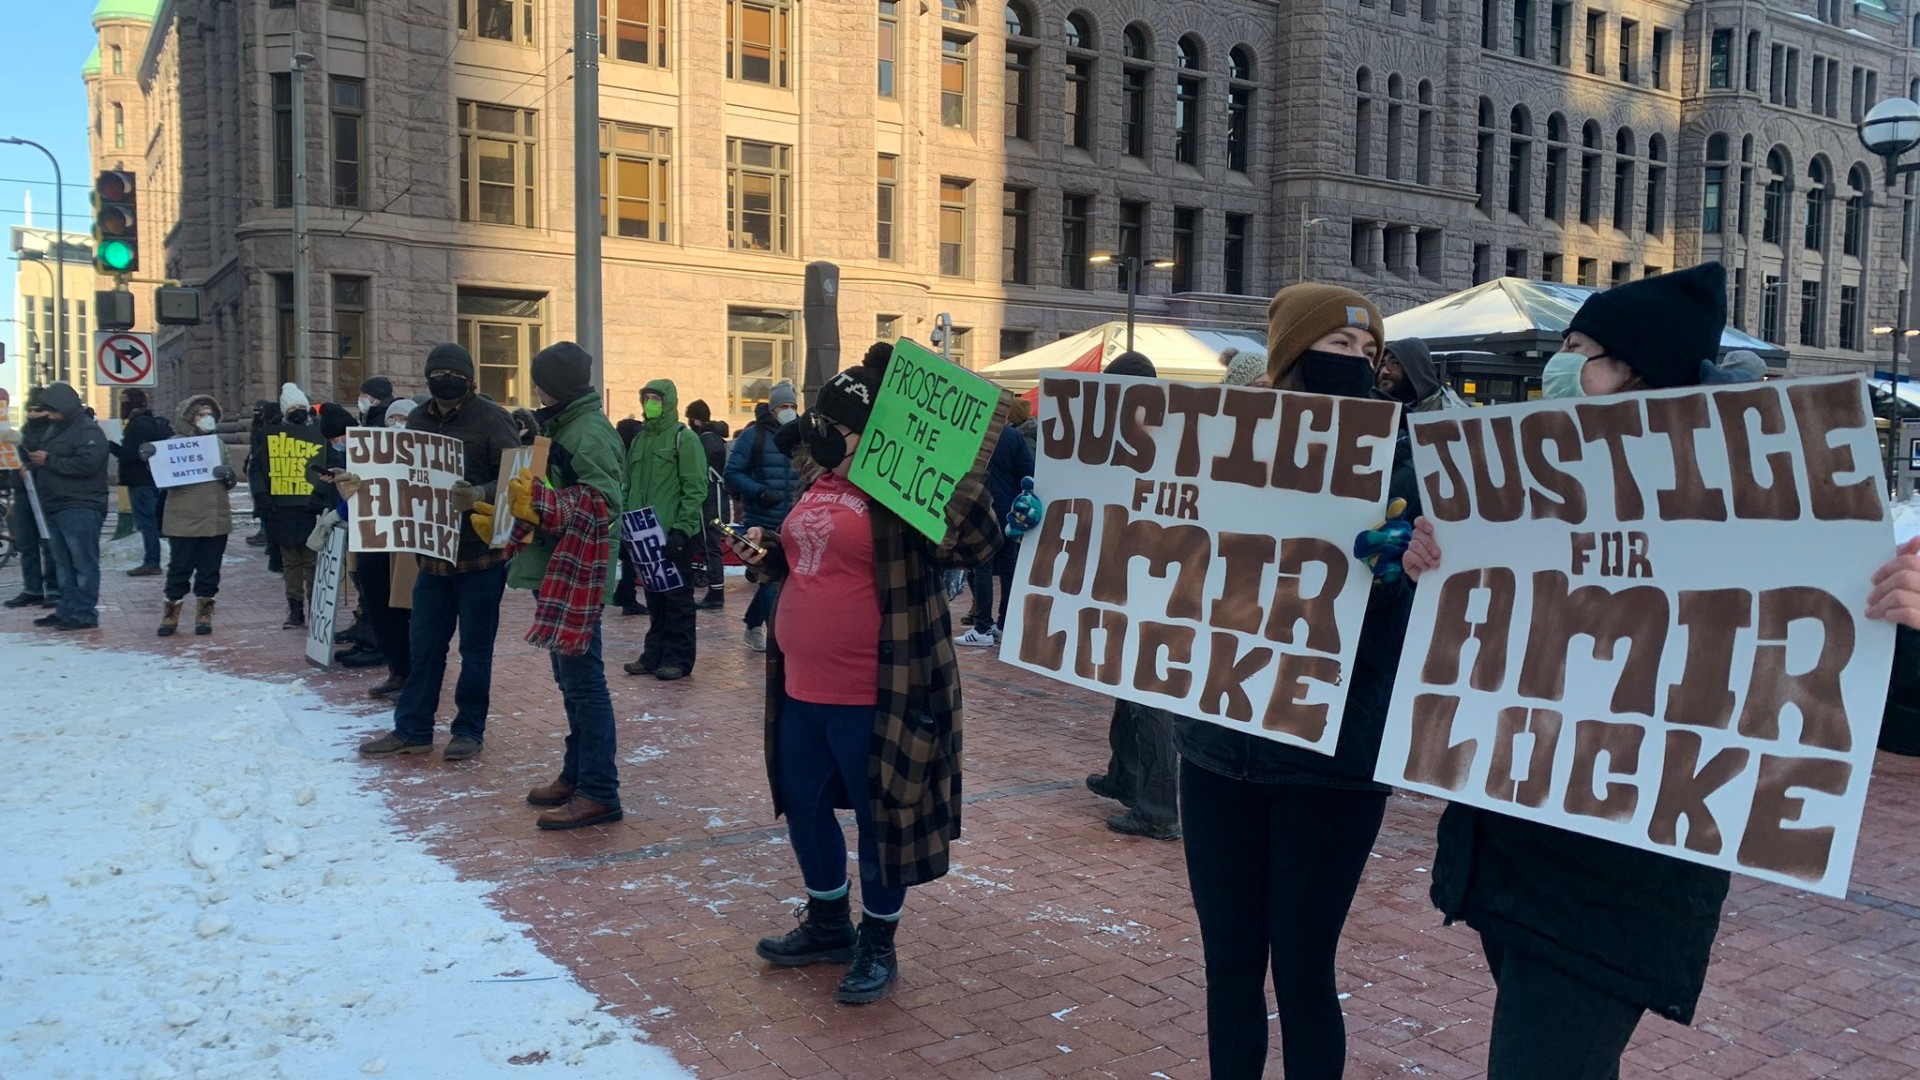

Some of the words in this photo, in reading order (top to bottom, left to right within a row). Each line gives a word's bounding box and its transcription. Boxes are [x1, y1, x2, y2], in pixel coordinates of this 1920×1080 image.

[887, 354, 988, 435] PROSECUTE
[168, 441, 199, 450] BLACK
[267, 432, 323, 458] BLACK
[349, 430, 463, 476] JUSTICE
[906, 413, 940, 451] THE
[1042, 378, 1395, 502] JUSTICE
[1414, 377, 1884, 523] JUSTICE
[170, 454, 203, 463] LIVES
[172, 468, 208, 477] MATTER
[268, 457, 308, 477] LIVES
[409, 468, 429, 484] FOR
[861, 428, 955, 519] POLICE
[1131, 478, 1199, 520] FOR
[324, 527, 335, 554] O
[1570, 531, 1653, 578] FOR
[317, 553, 337, 590] ORE
[1028, 498, 1349, 654] AMIR
[309, 611, 331, 646] NOCK
[1018, 593, 1342, 743] LOCKE
[1421, 566, 1855, 752] AMIR
[1402, 693, 1853, 883] LOCKE
